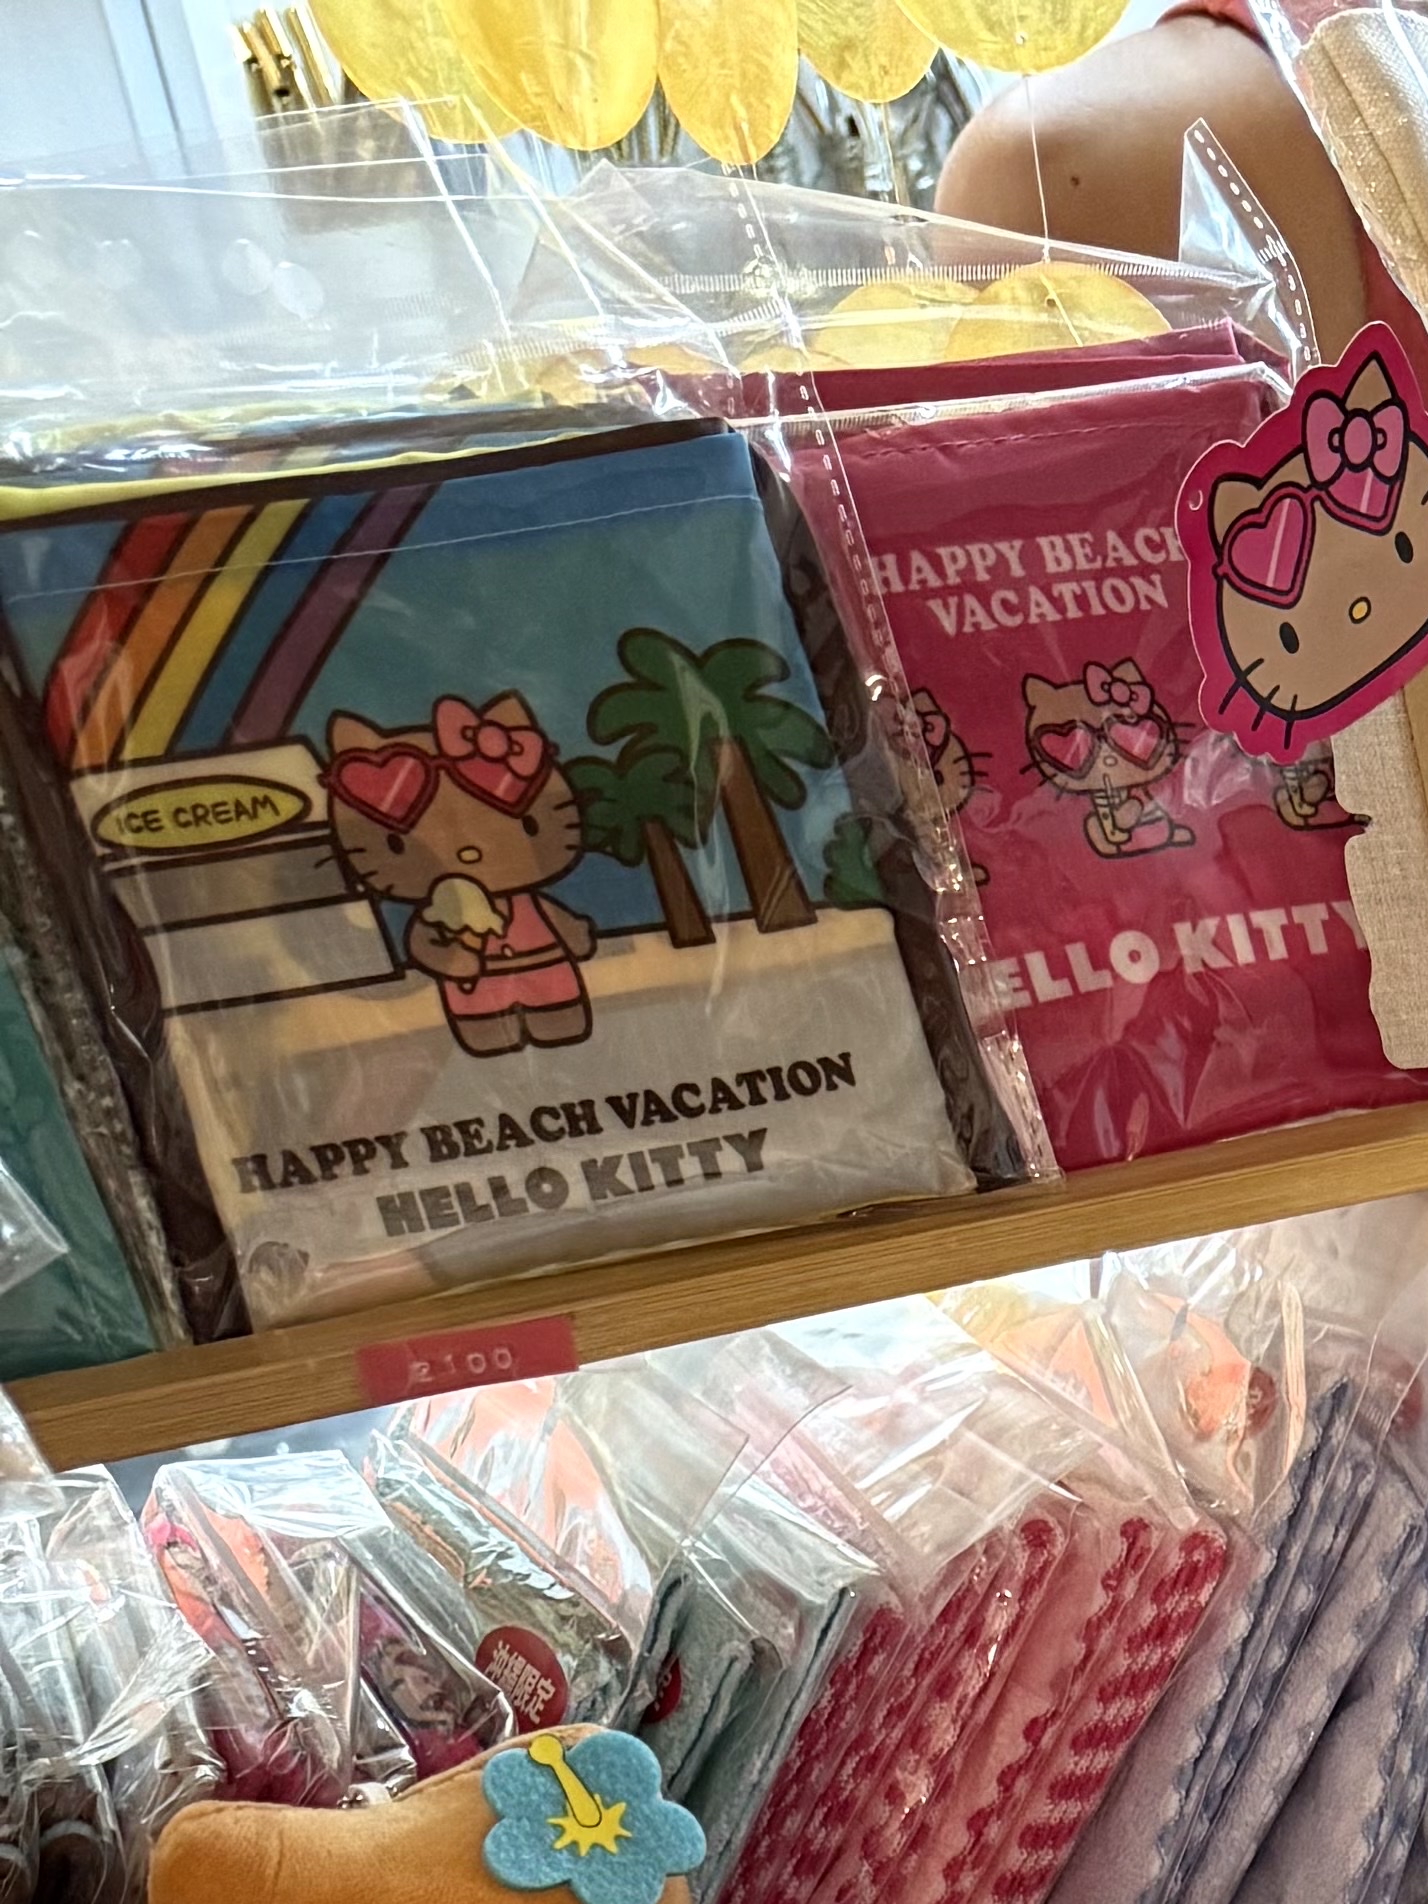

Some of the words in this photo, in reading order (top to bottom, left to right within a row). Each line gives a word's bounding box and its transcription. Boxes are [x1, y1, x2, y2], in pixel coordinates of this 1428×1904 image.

[871, 539, 1027, 596] HAPPY
[926, 573, 1169, 638] VACATION
[112, 806, 167, 837] ICE
[171, 793, 283, 831] CREAM
[990, 929, 1160, 1011] ELLO
[230, 1135, 414, 1199] HAPPY
[422, 1099, 604, 1167] BEACH
[604, 1051, 860, 1134] VACATION
[373, 1162, 570, 1239] HELLO
[590, 1127, 769, 1203] KITTY
